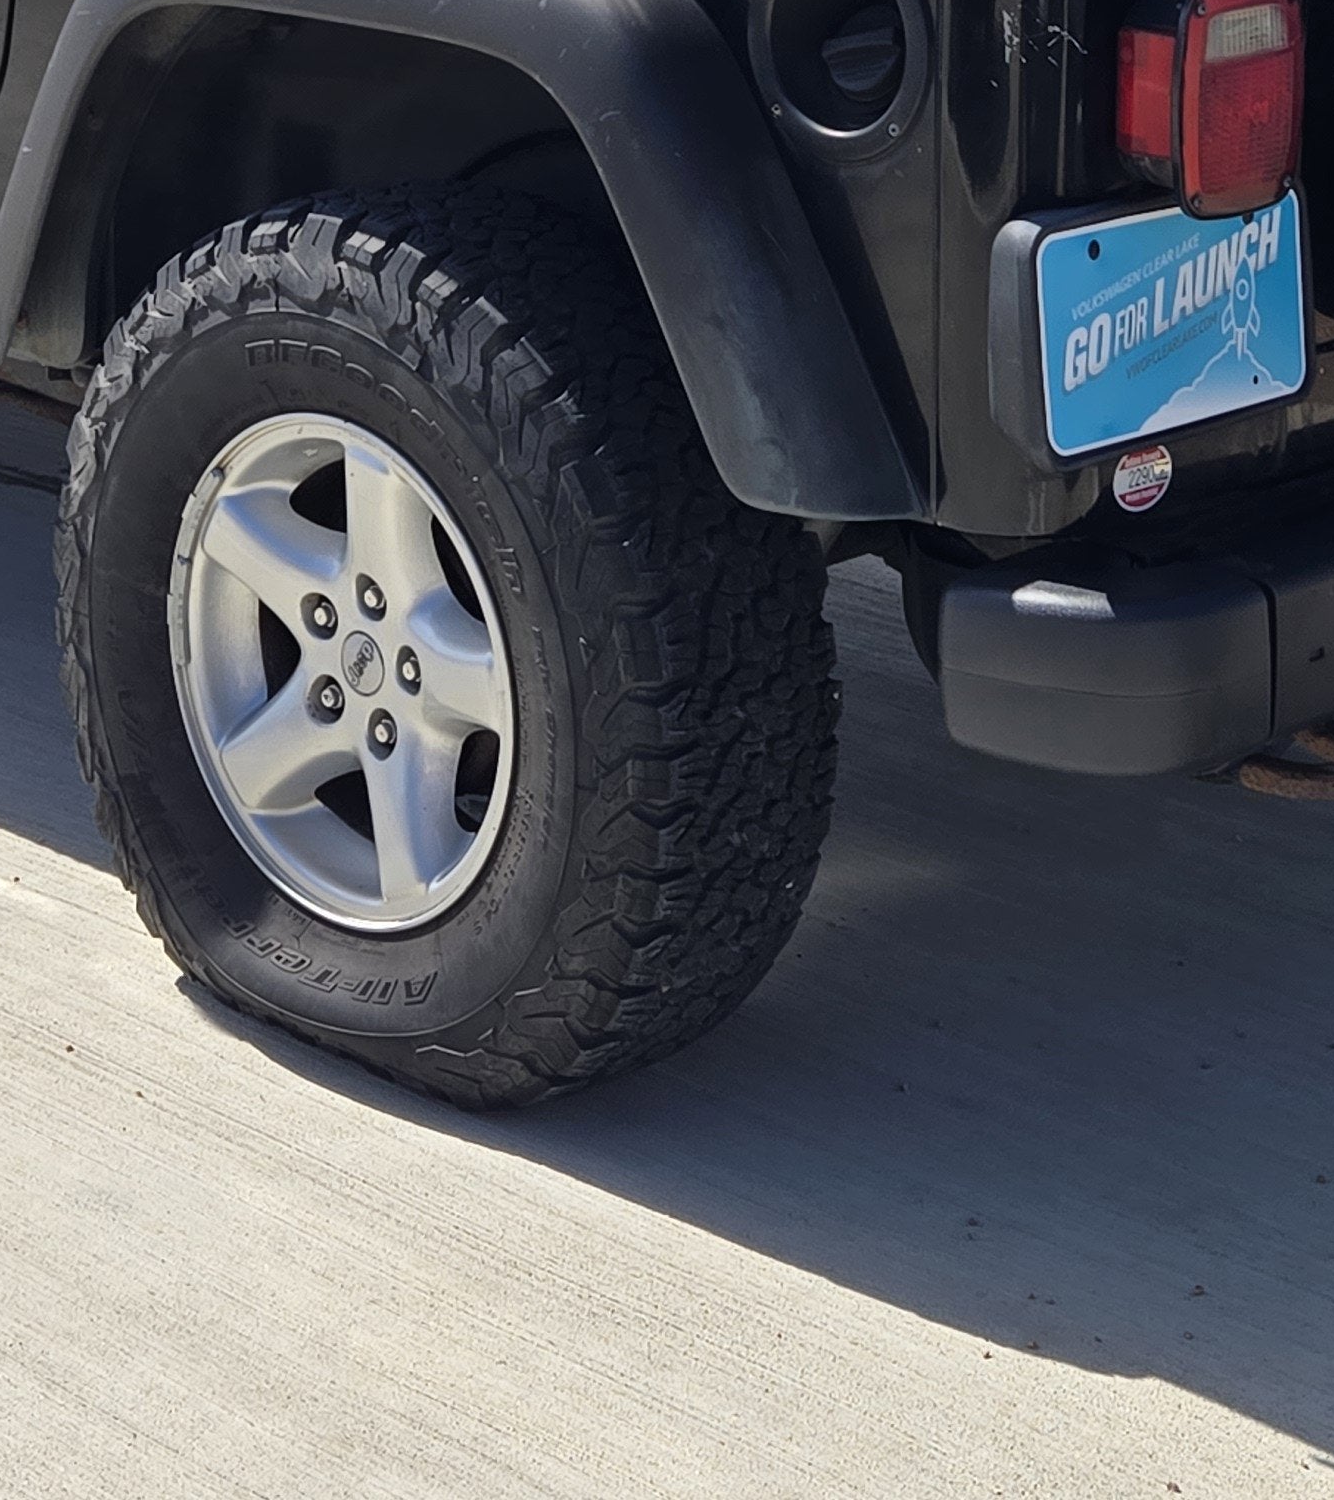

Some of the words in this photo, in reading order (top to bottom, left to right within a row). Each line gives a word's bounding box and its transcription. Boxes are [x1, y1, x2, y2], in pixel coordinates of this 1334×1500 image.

[1063, 311, 1113, 393] GO
[1114, 296, 1149, 358] FOR
[1153, 205, 1282, 339] LAUNCH
[1070, 267, 1142, 321] VOLKSWAGEN
[1141, 247, 1178, 283] CLEAR
[1175, 233, 1201, 260] LAKE
[347, 639, 375, 687] Jeep
